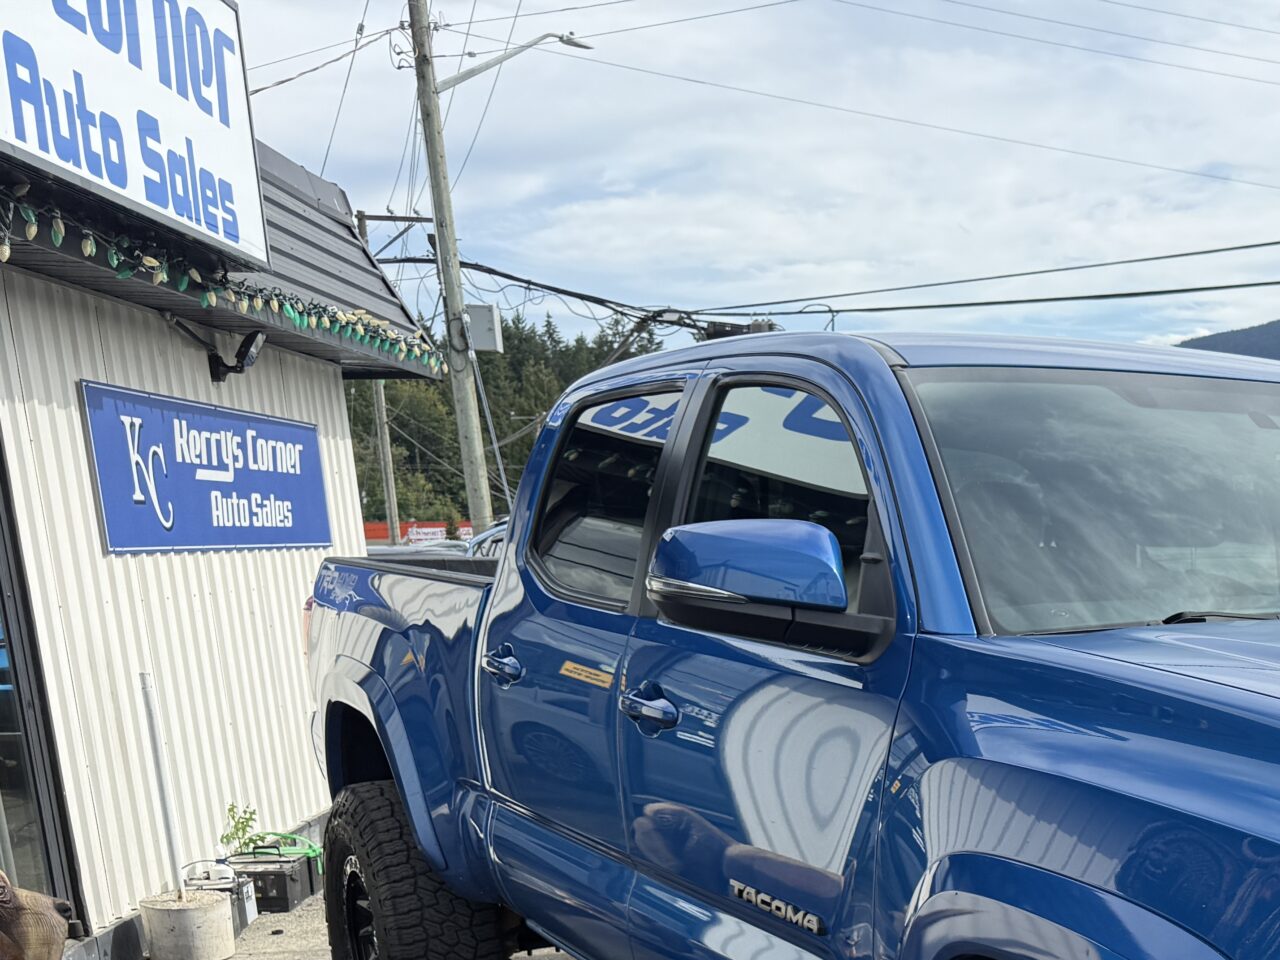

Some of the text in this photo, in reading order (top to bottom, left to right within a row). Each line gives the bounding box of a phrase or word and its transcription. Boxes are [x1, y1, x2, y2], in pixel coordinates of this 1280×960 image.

[52, 0, 236, 128] rner
[3, 30, 240, 244] Auto Sales
[246, 429, 303, 475] Corner
[210, 490, 293, 527] Auto Sales
[729, 878, 822, 935] TACOMA
